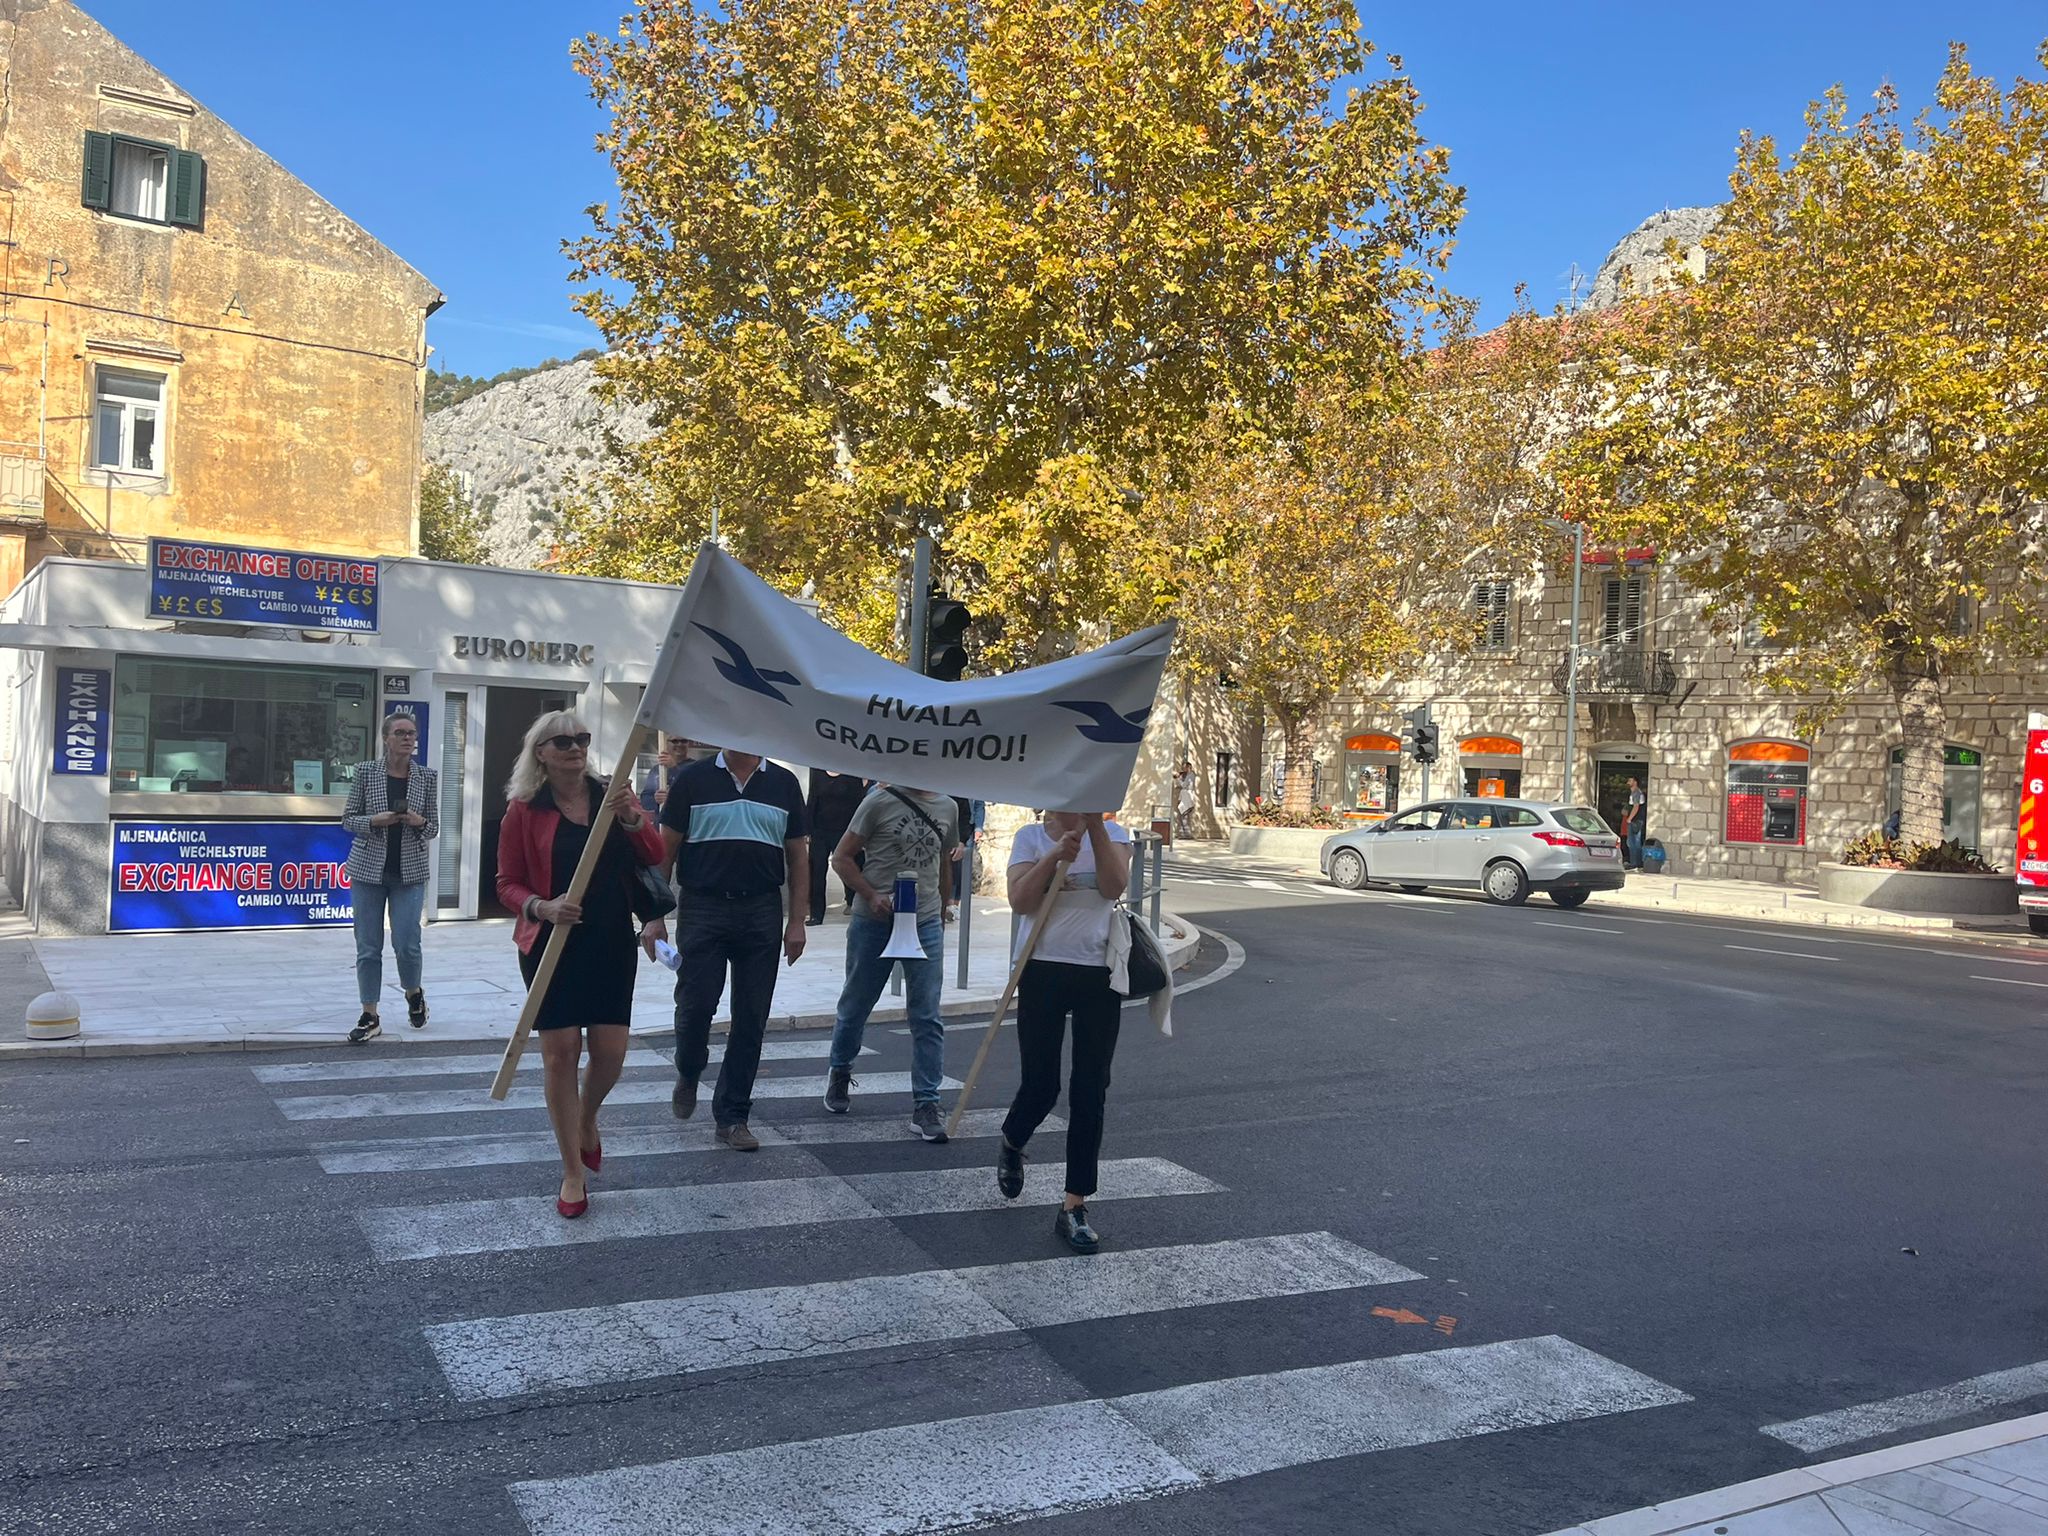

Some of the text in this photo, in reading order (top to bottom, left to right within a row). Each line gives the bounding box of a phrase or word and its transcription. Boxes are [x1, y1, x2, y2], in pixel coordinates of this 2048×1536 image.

[44, 257, 250, 320] R A
[158, 544, 376, 585] EXCHANGE OFFICE
[158, 570, 233, 585] MJENJAČNICA
[209, 586, 284, 600] WECHELSTUBE
[259, 601, 338, 616] CAMBIO VALUTE
[453, 635, 594, 666] EUROHERC
[866, 694, 982, 727] HVALA
[65, 672, 98, 771] EXCHANGE
[815, 718, 1028, 762] GRADE MOJ!
[2030, 779, 2044, 794] 6
[120, 828, 206, 843] MJENJAČNICA
[179, 846, 267, 858] WECHELSTUBE
[119, 861, 352, 891] EXCHANGE OFFIC
[237, 893, 328, 907] CAMBIO VALUTE
[308, 904, 354, 919] SMĚNÁR
